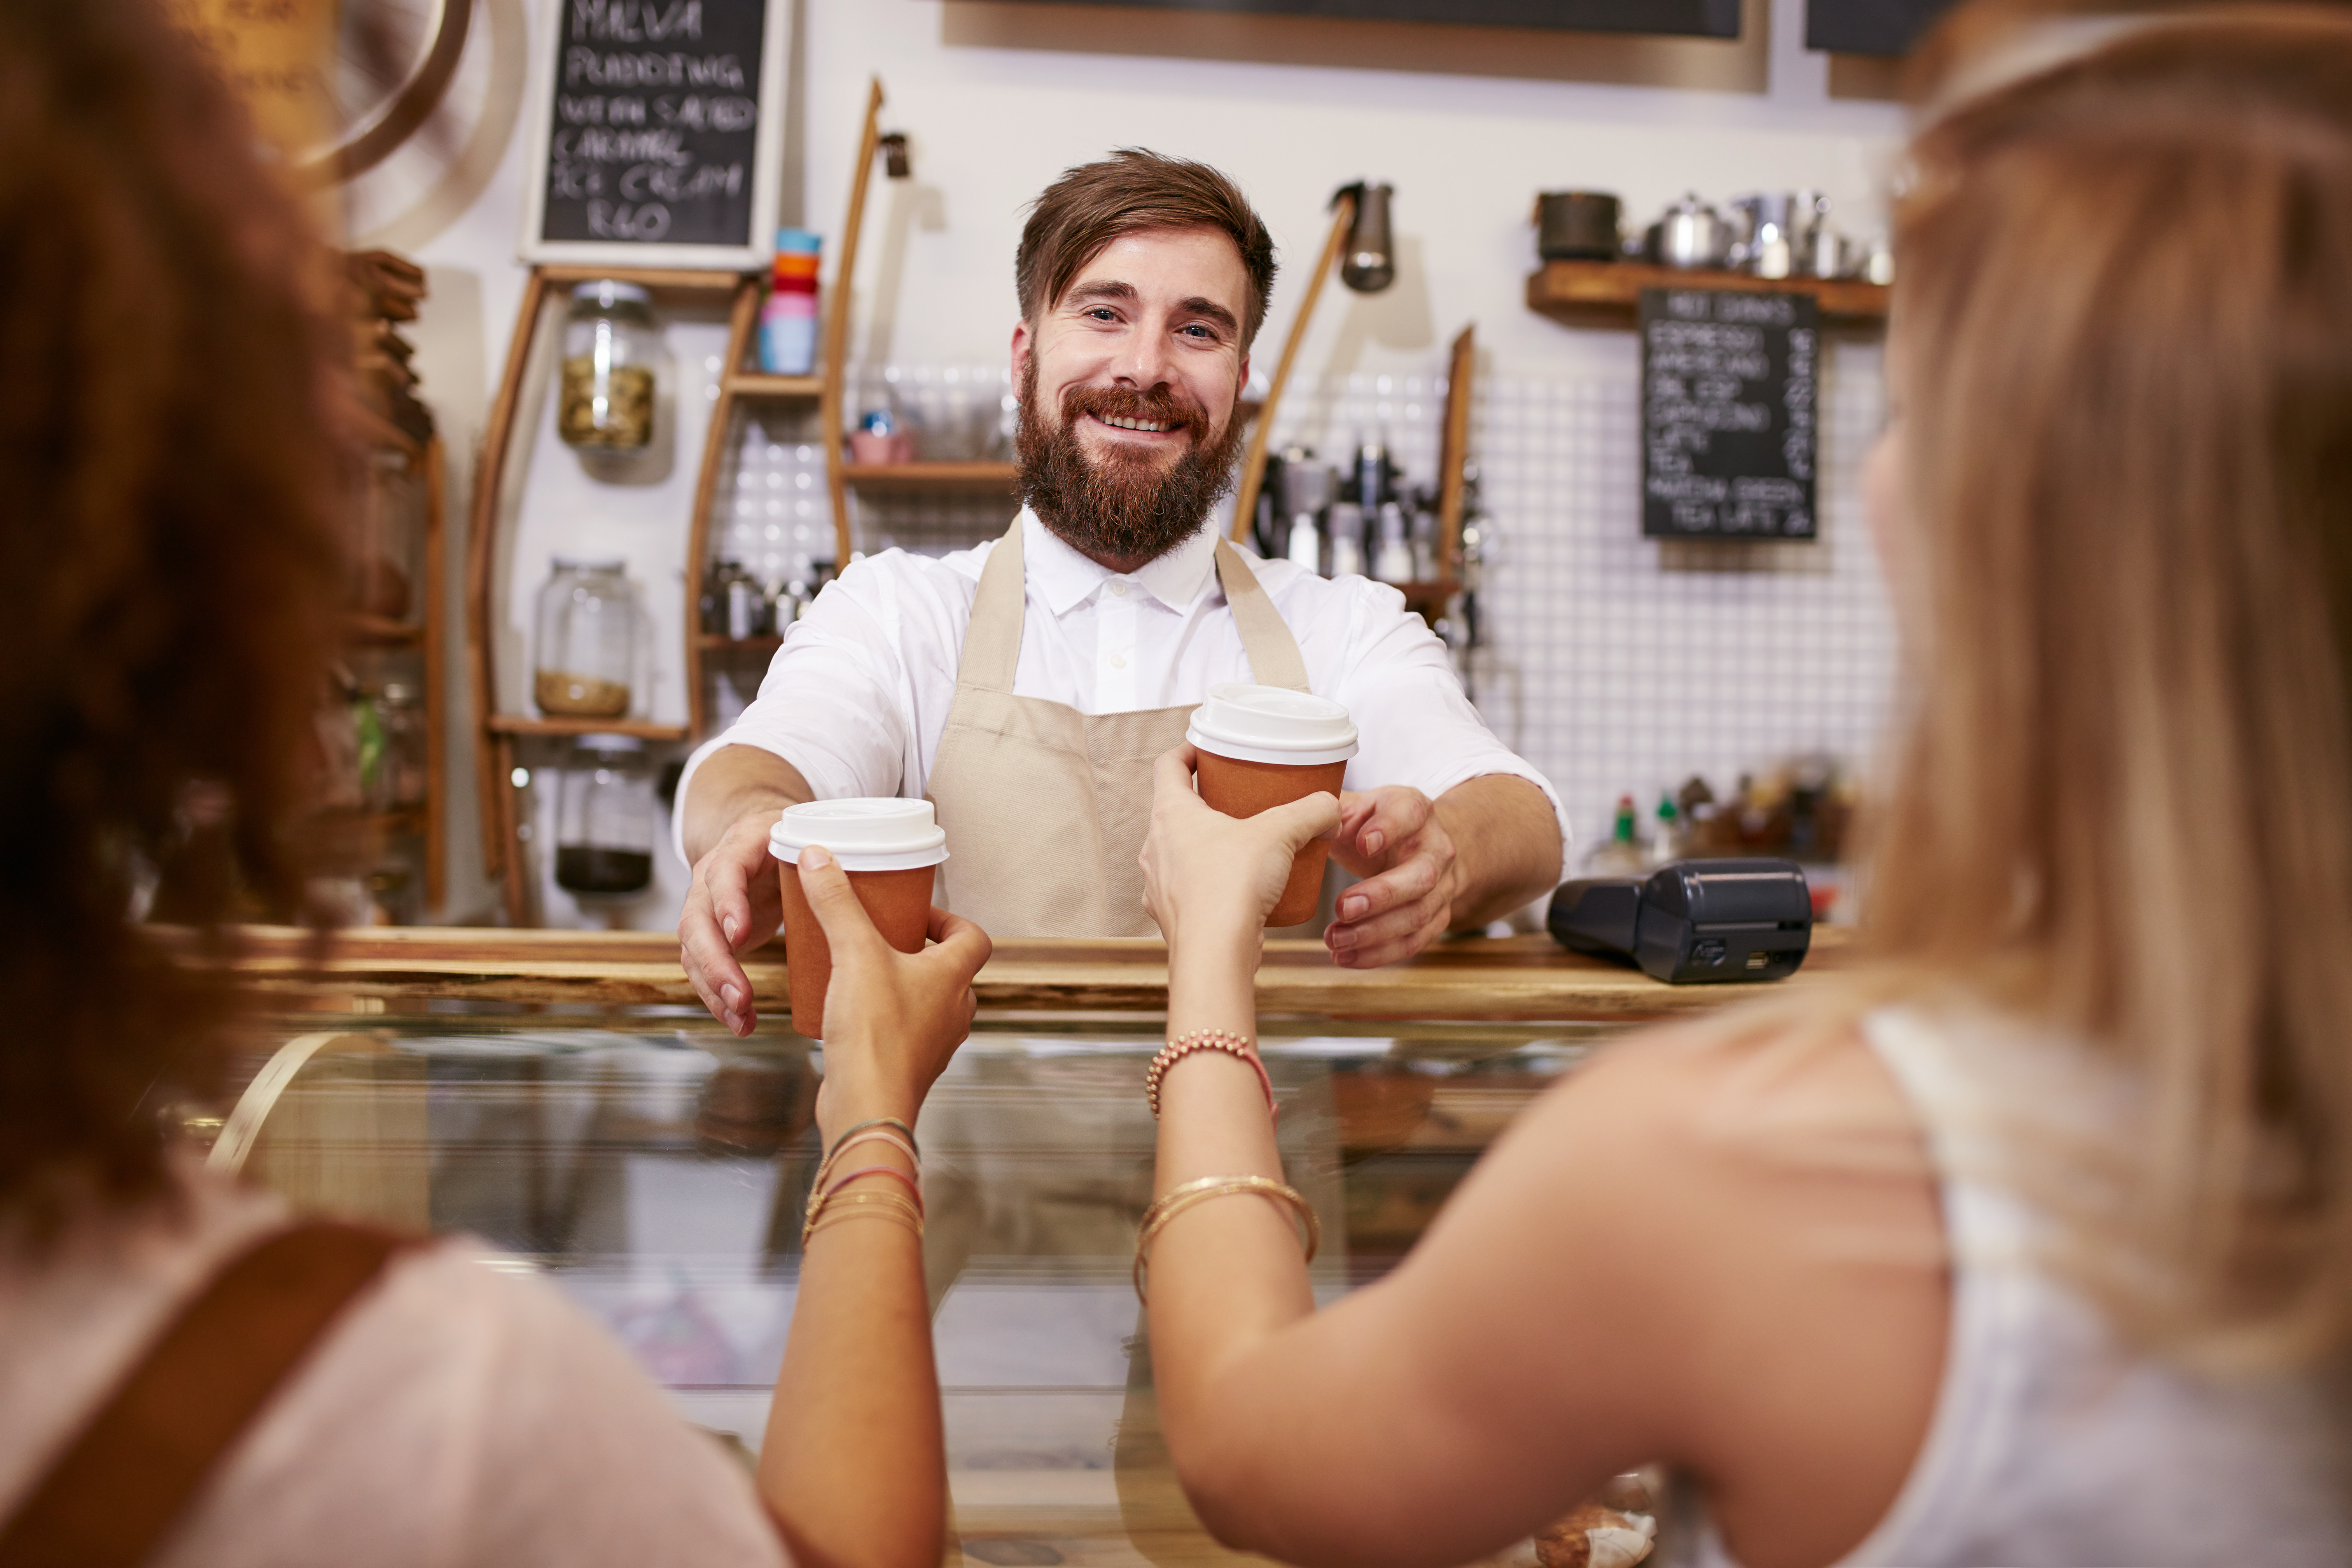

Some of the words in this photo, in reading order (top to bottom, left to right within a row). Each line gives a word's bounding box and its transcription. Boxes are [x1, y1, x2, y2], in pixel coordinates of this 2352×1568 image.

[568, 47, 742, 91] PUDDING
[554, 128, 695, 164] CARAMEL
[621, 164, 741, 199] CREAM
[1670, 292, 1710, 317] HOT
[1717, 295, 1795, 322] DRINKS
[1651, 322, 1761, 354] ESPRESSO
[1650, 348, 1767, 378] AMERICANO
[1648, 400, 1768, 430] CAPPUCCINO
[1650, 450, 1692, 476] TEA
[1649, 474, 1729, 502] MATCHA
[1733, 478, 1803, 506] GREEN
[1671, 502, 1714, 528] TEA
